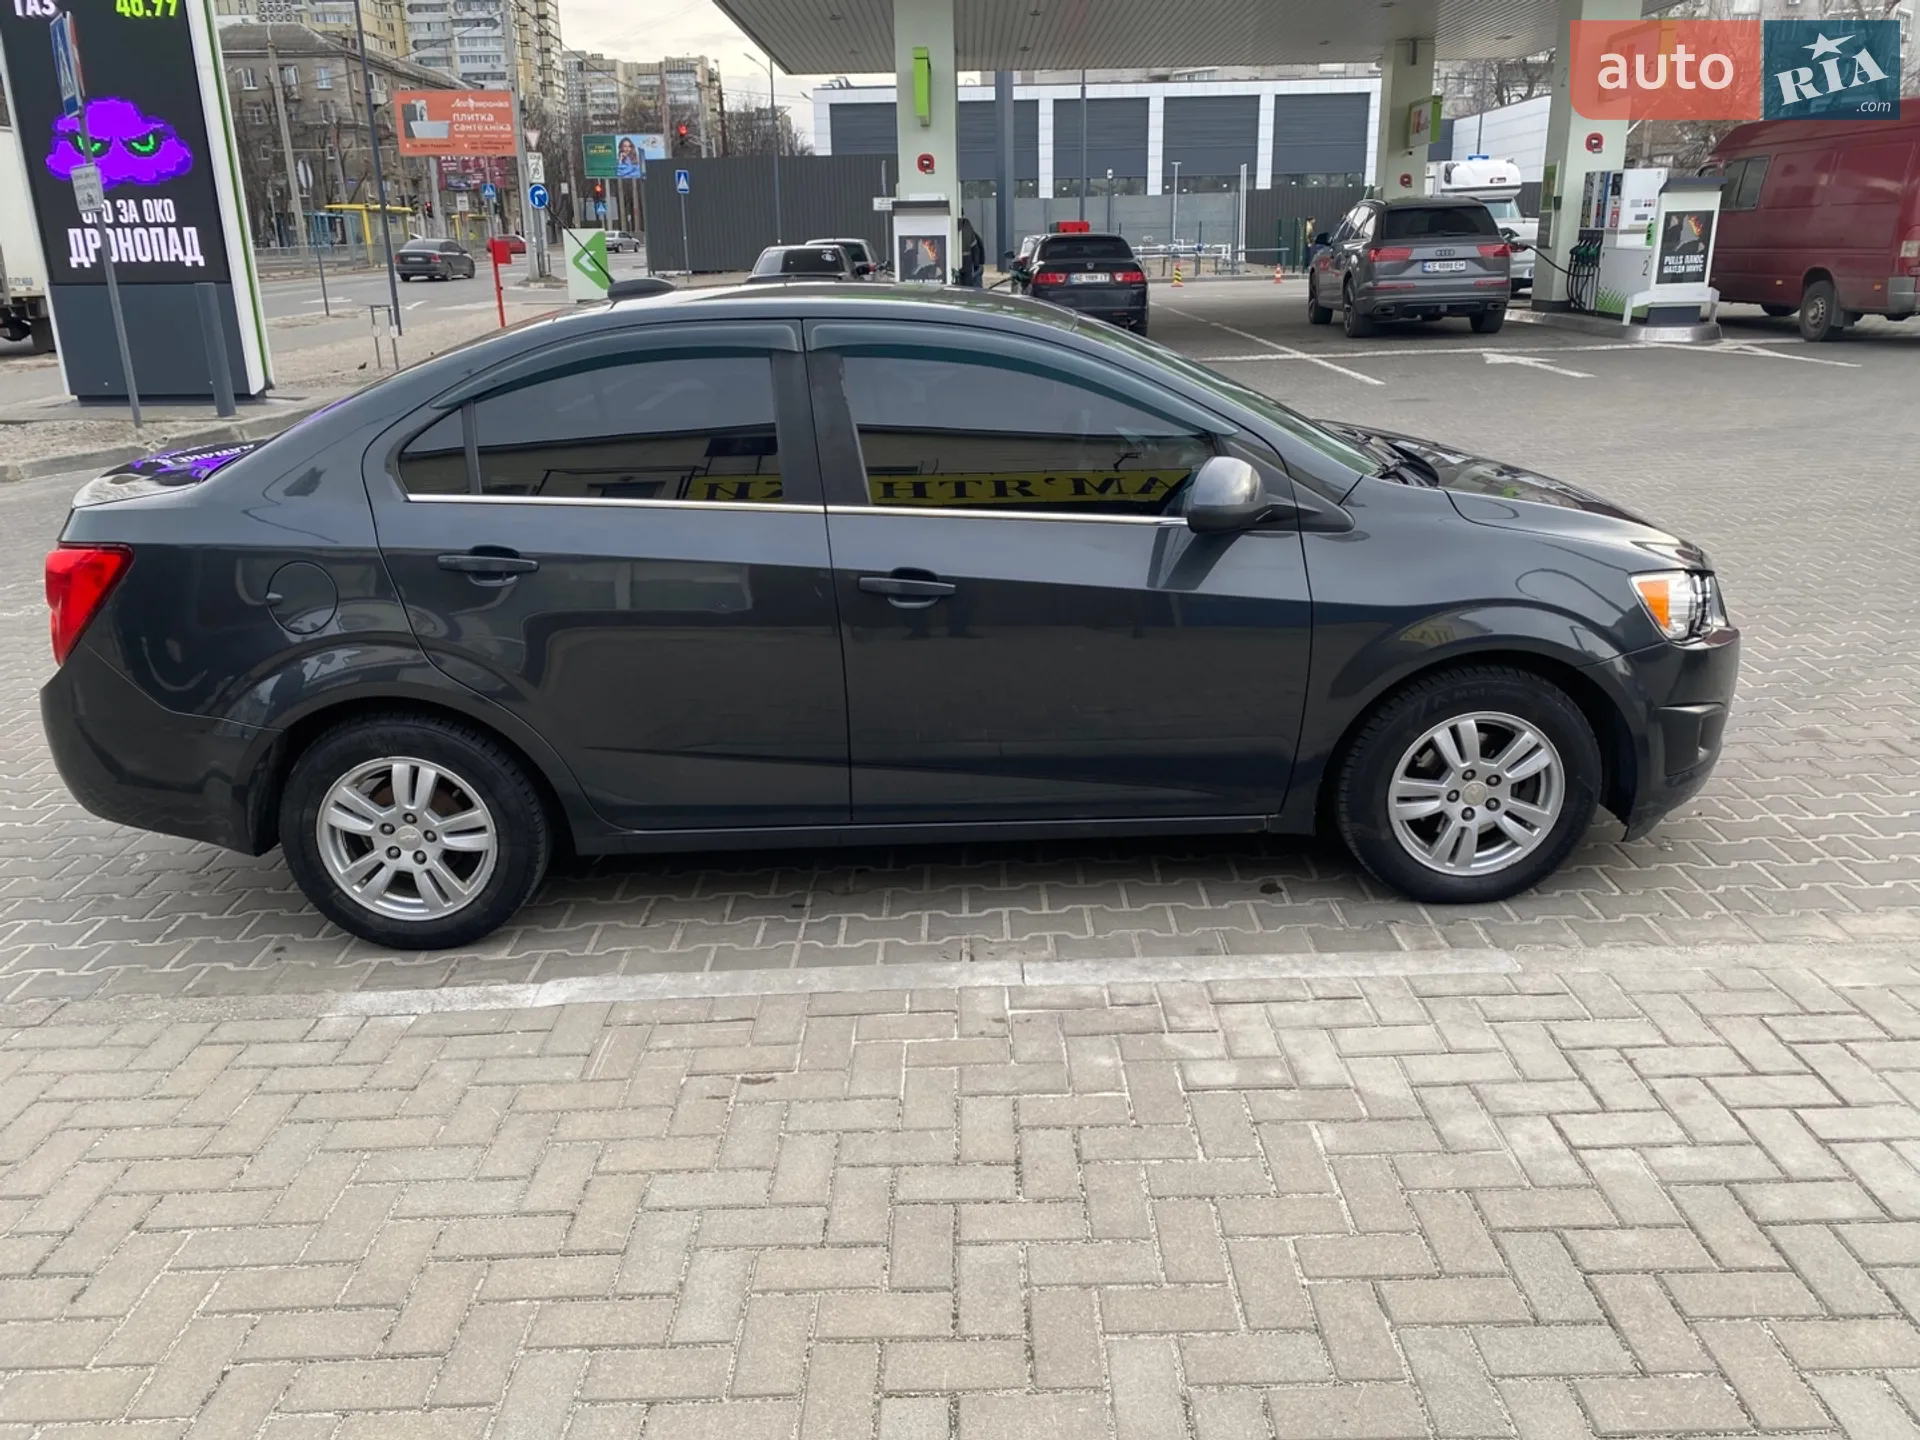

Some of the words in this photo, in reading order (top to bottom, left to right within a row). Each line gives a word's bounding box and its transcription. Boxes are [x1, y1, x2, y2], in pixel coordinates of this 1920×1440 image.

[453, 113, 494, 122] плитка
[453, 121, 511, 131] сантехніка
[116, 199, 140, 223] ЗА
[142, 198, 176, 223] ОКО
[1642, 260, 1649, 276] 2
